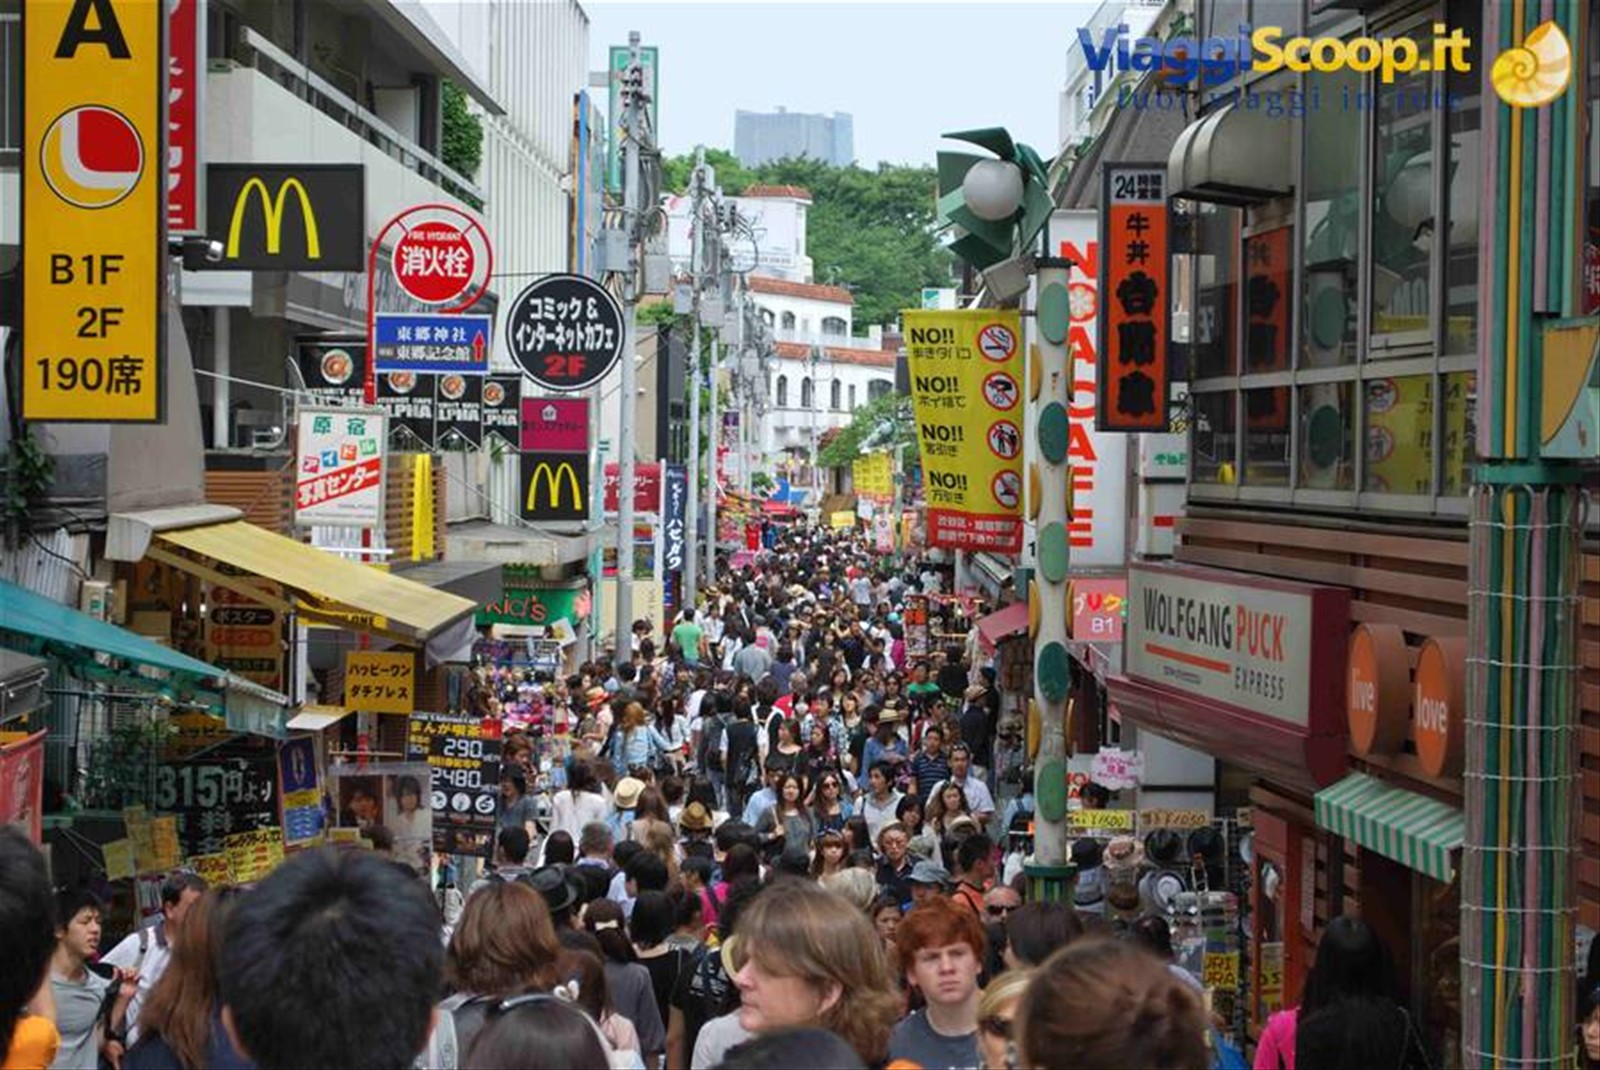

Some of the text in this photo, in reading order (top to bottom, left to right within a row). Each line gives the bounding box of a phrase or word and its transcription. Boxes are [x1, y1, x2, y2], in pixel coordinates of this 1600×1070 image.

[51, 254, 124, 284] B1F
[401, 245, 470, 277] 消火栓
[529, 297, 599, 320] コミック &
[77, 307, 123, 338] 2F
[515, 322, 614, 352] インターネットカフェ
[911, 328, 955, 344] NO!!
[37, 356, 143, 395] 190席
[544, 356, 586, 377] 2F
[916, 376, 959, 393] NO!!
[921, 424, 964, 441] NO!!
[929, 470, 968, 490] NO!!
[1091, 617, 1114, 634] B1
[1143, 587, 1285, 662] WOLFGANG PUCK
[348, 663, 411, 677] ハッピーワン
[1235, 666, 1284, 700] EXPRESS
[1351, 667, 1375, 712] live
[1415, 683, 1448, 734] love
[443, 738, 483, 758] 290
[430, 767, 481, 788] 2480
